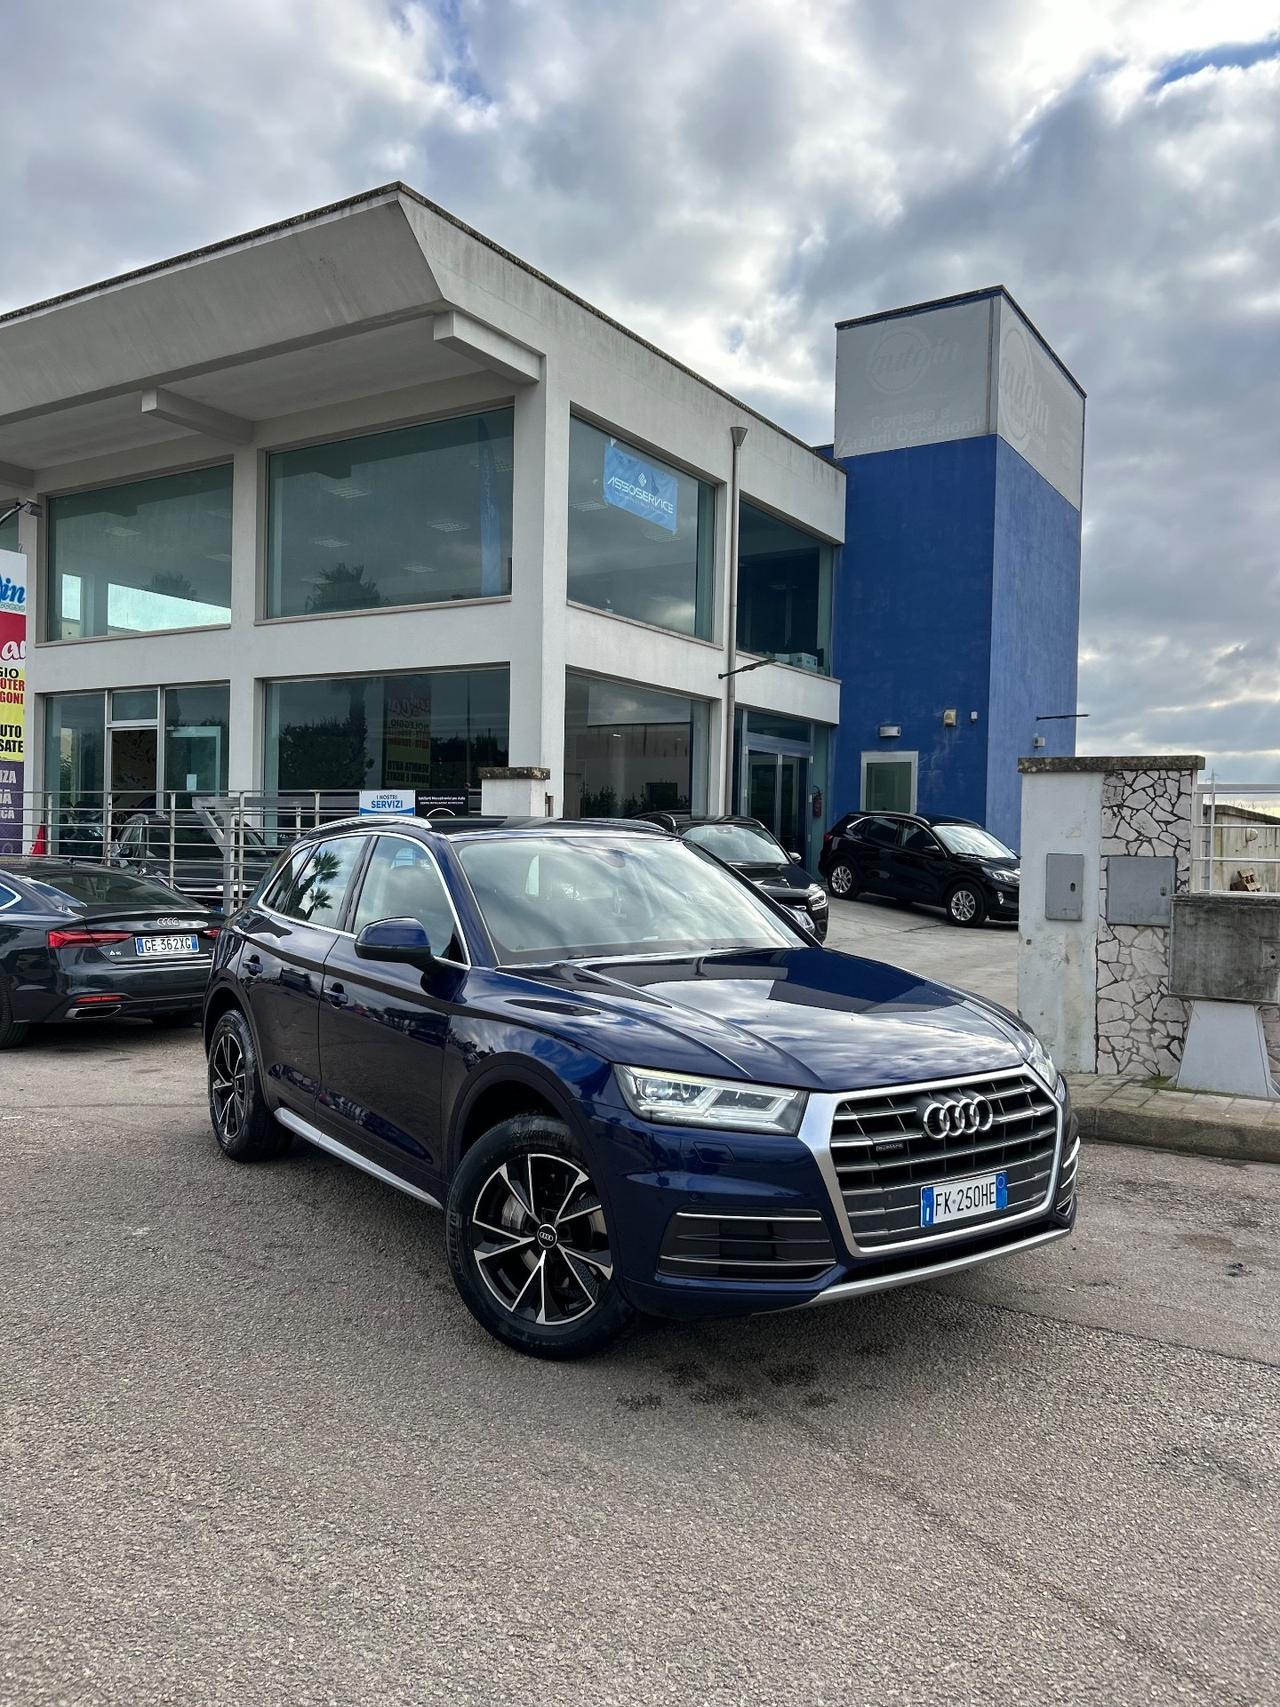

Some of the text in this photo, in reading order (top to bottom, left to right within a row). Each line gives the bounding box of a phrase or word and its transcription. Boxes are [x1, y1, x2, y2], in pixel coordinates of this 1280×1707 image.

[371, 800, 403, 809] SERVIZI
[145, 937, 191, 952] GE 362XG
[935, 1182, 996, 1217] FK 250HE
